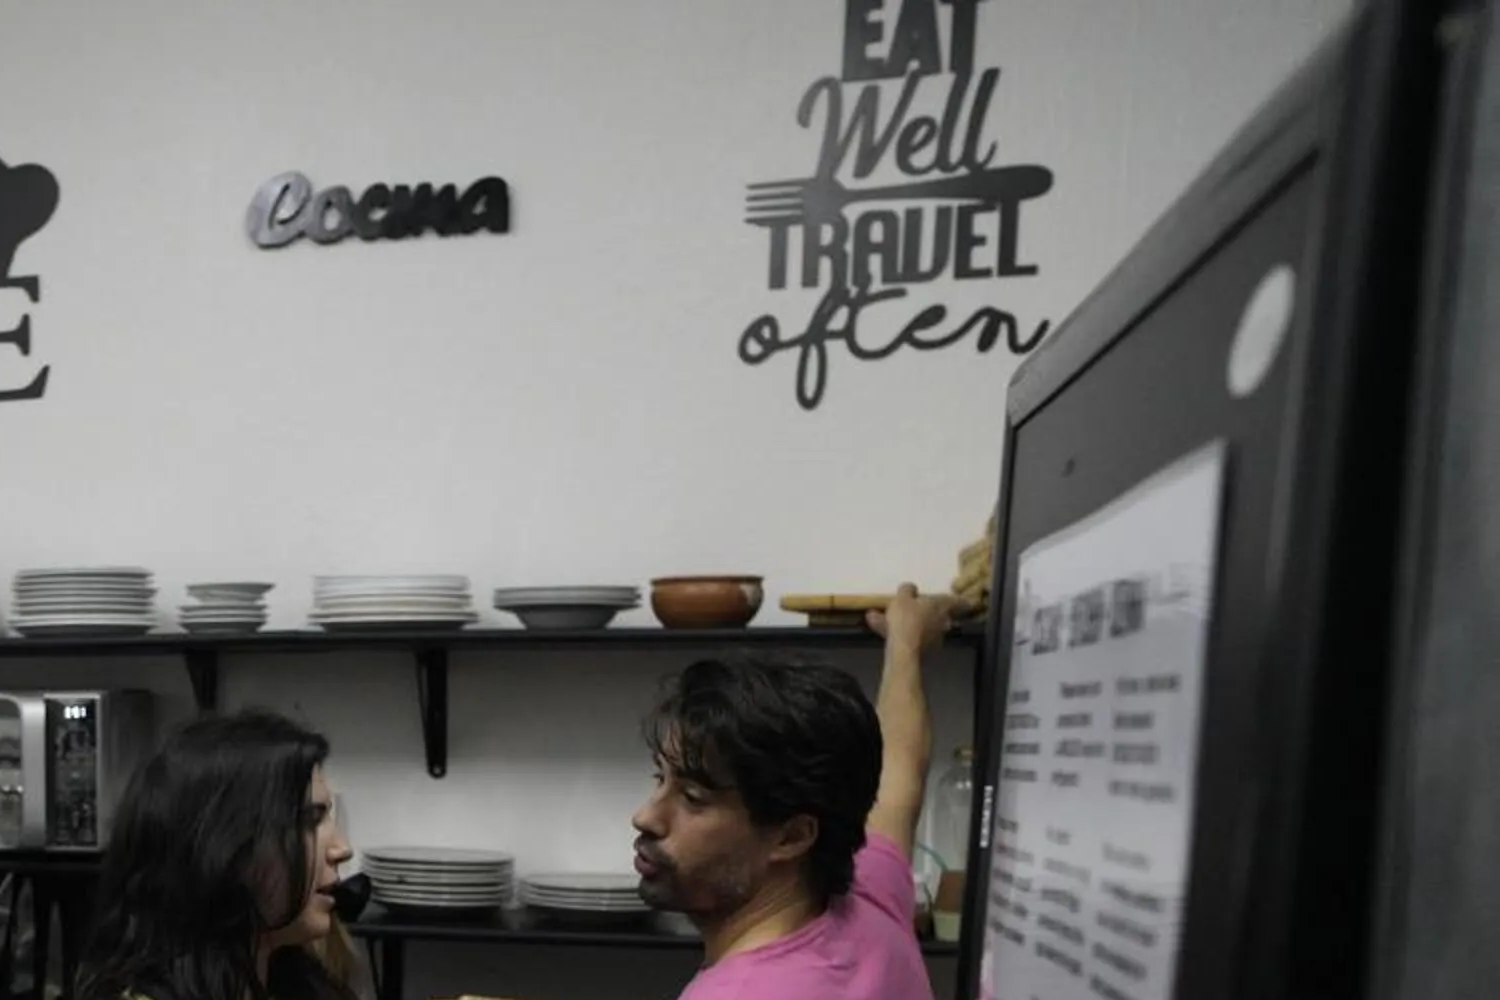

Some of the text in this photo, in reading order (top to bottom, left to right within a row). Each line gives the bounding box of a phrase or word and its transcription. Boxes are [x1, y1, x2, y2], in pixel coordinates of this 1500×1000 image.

[842, 0, 988, 82] EAT
[797, 67, 1000, 180] Well
[756, 199, 1039, 290] TRAVEL
[739, 276, 1050, 410] often
